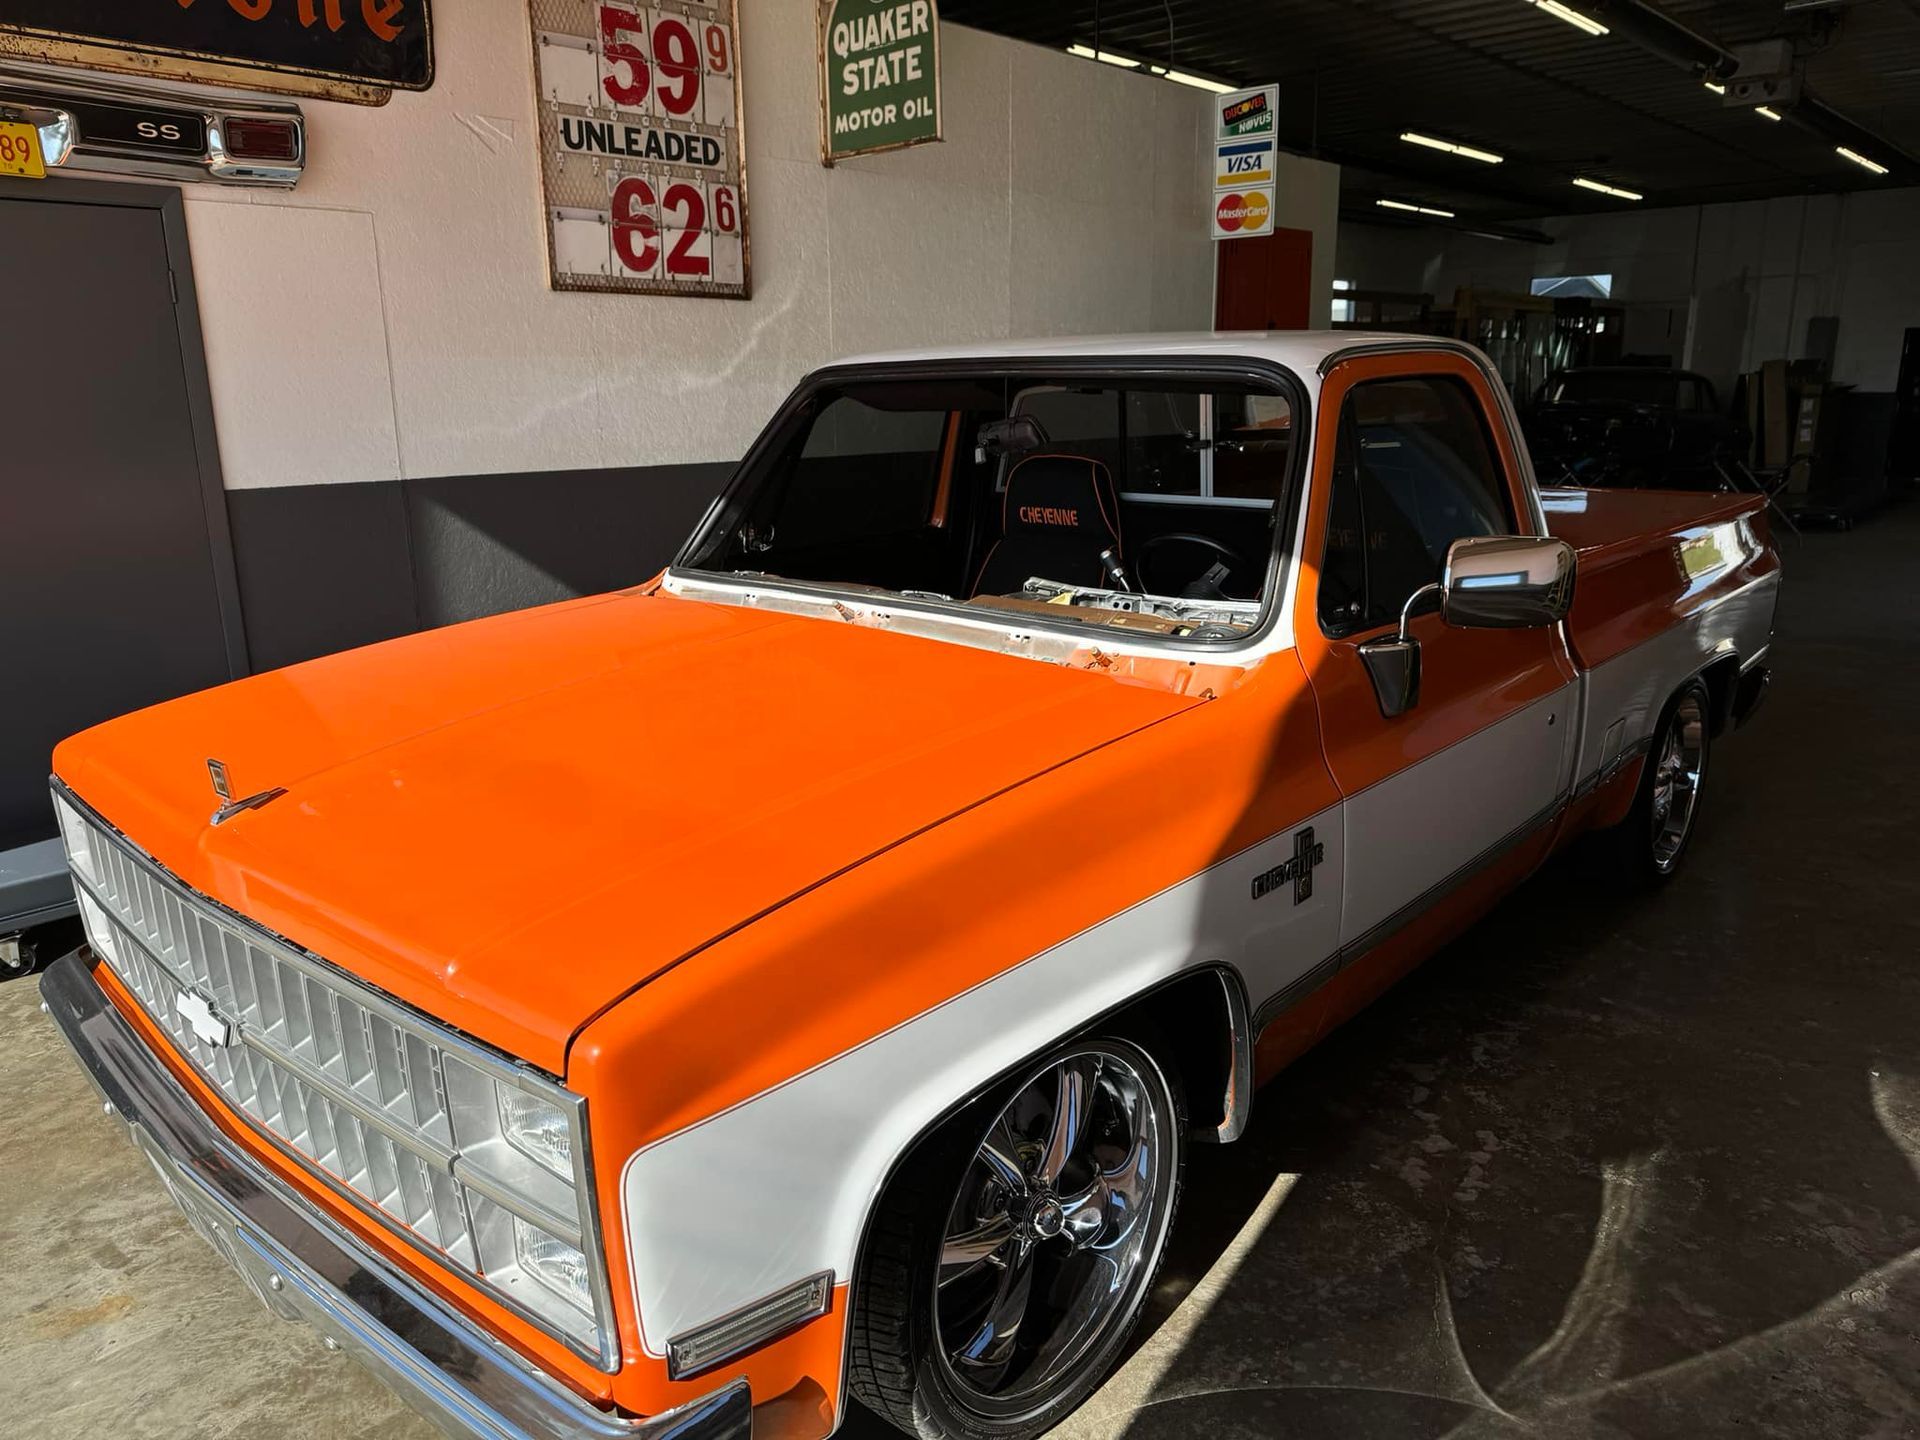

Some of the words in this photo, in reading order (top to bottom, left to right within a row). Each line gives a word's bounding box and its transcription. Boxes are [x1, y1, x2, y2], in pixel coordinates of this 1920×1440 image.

[833, 0, 929, 59] QUAKER
[843, 45, 922, 96] STATE
[835, 104, 897, 134] MOTOR
[903, 97, 933, 120] OIL
[1239, 112, 1272, 133] NOVUS
[137, 122, 181, 140] SS
[562, 117, 721, 167] UNLEADED
[1227, 154, 1263, 174] VISA
[1218, 205, 1268, 220] MasterCard
[1020, 505, 1079, 527] CHEYENNE
